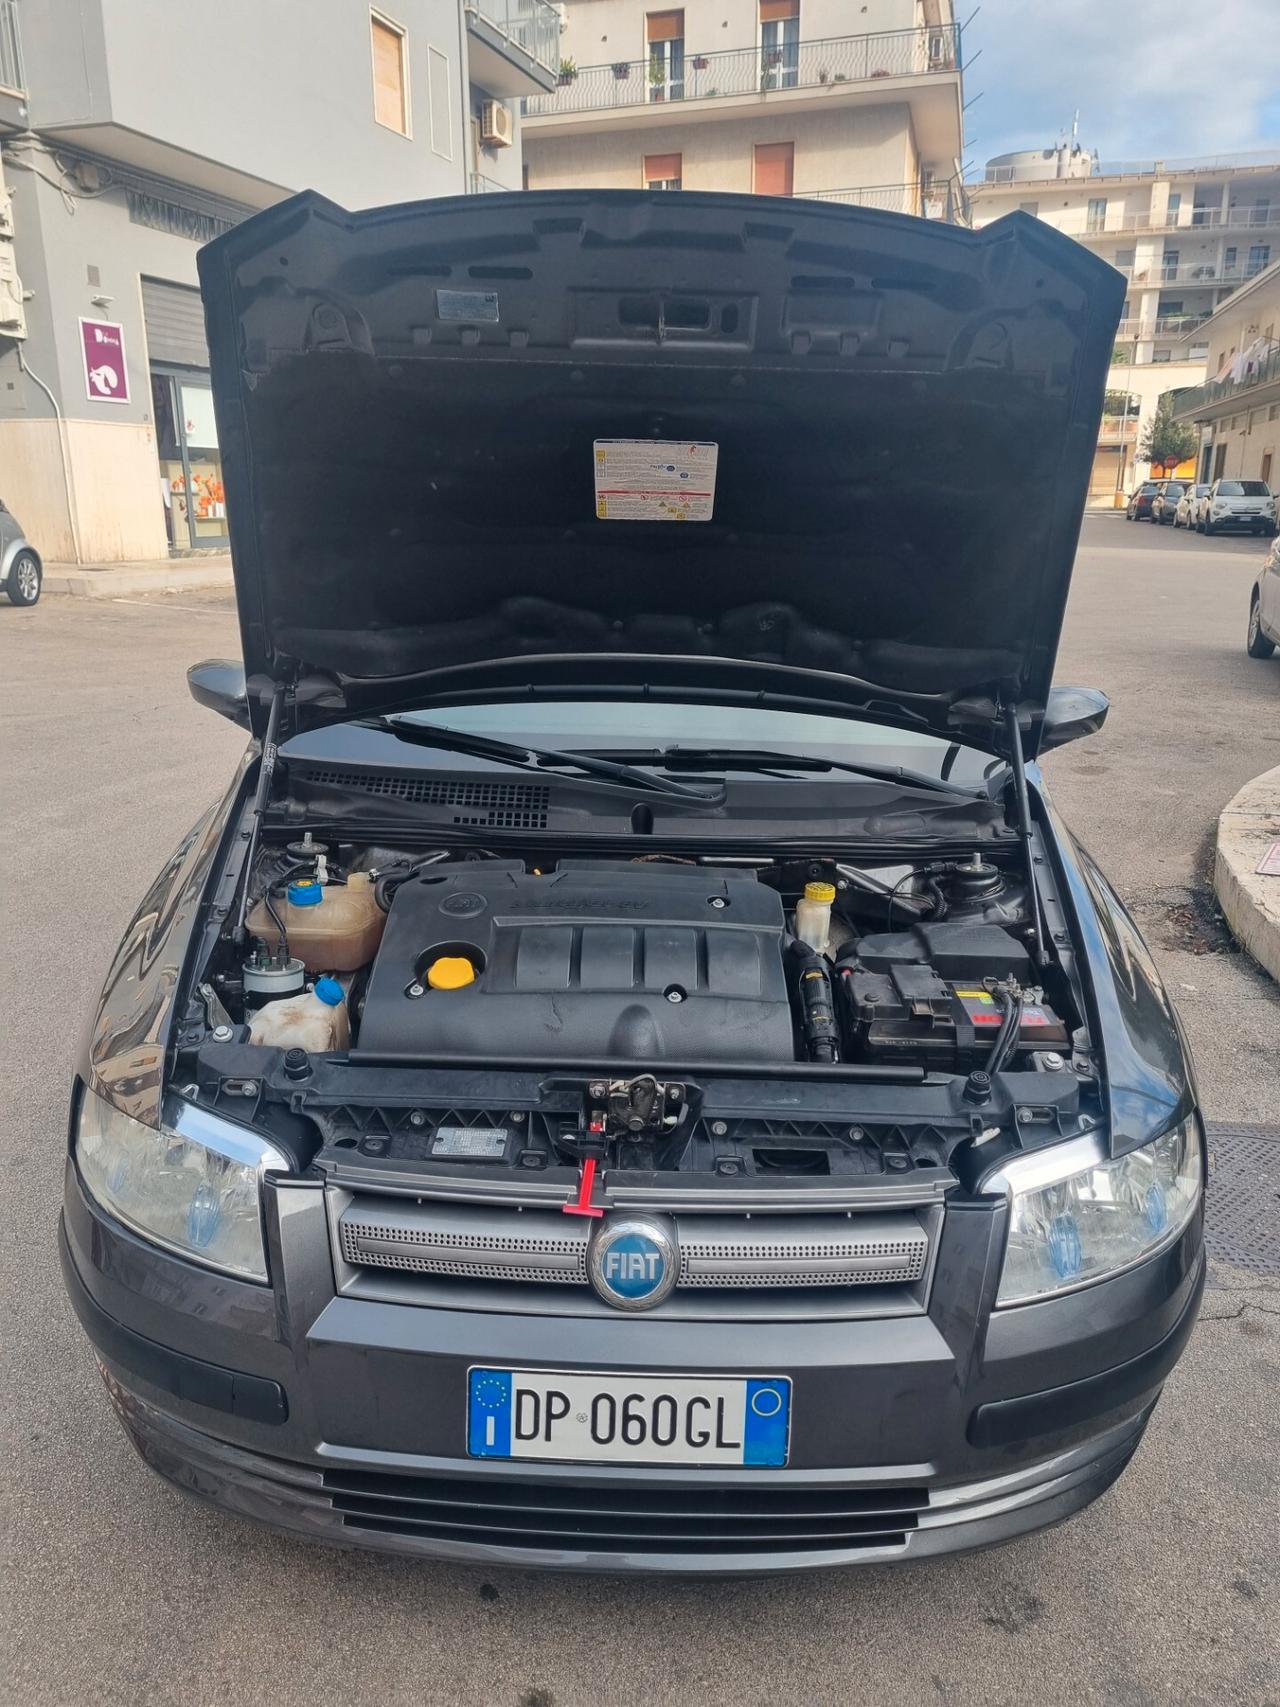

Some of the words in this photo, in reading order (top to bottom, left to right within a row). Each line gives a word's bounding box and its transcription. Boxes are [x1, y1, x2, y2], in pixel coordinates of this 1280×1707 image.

[606, 1252, 660, 1280] FIAT
[515, 1388, 571, 1442] DP
[590, 1392, 741, 1449] 060GL
